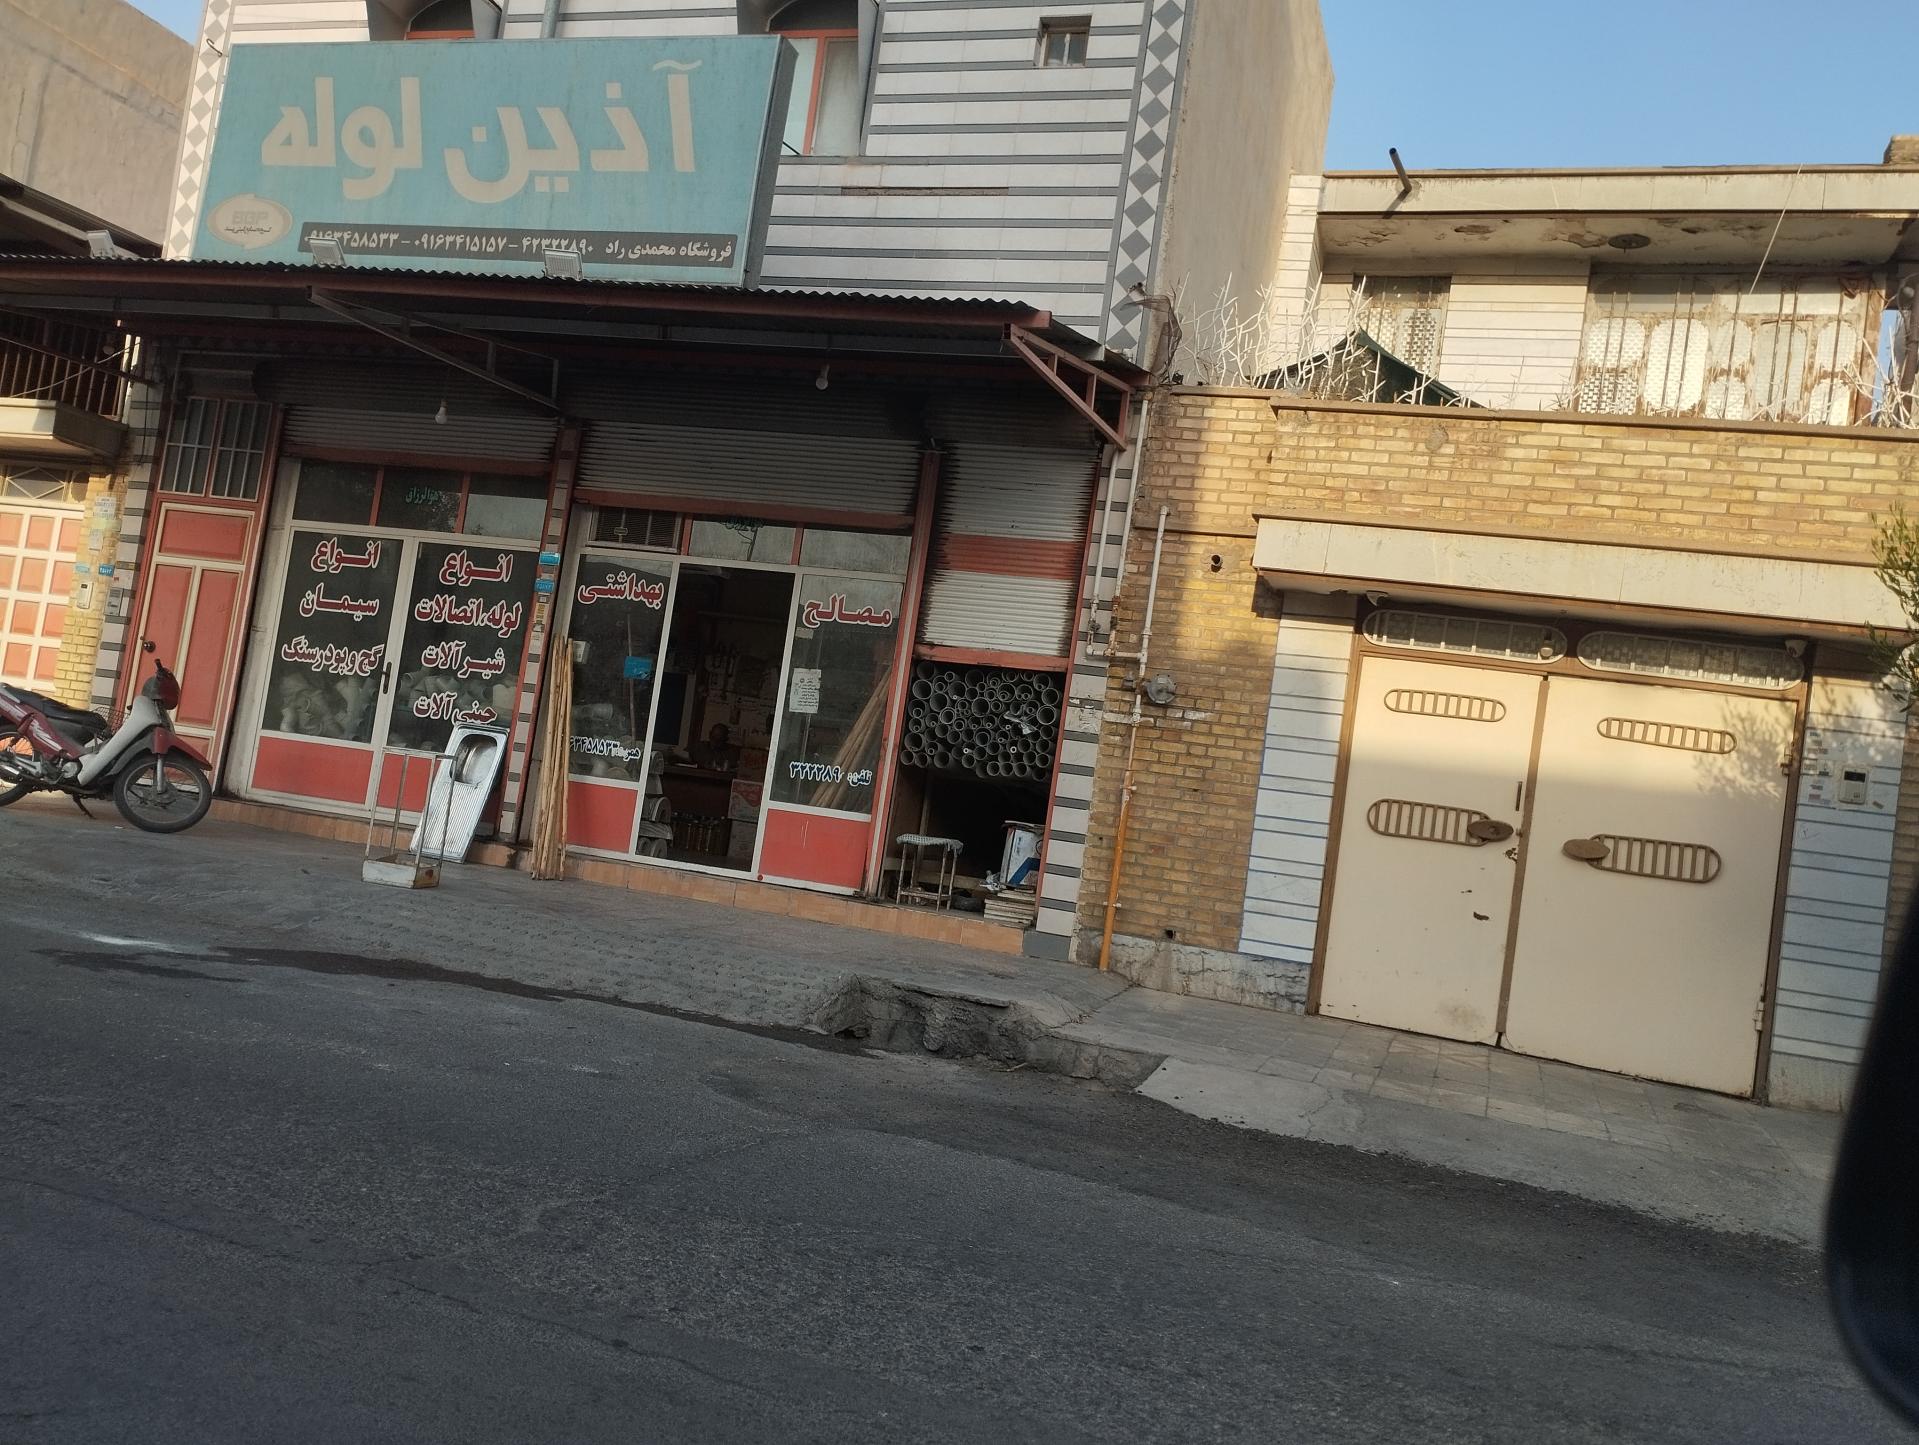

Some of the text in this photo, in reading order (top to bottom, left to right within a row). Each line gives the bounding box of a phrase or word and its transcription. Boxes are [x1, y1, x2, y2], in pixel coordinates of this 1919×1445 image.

[261, 59, 702, 203] آذین لوله
[414, 232, 507, 252] ۰۹۱۶۳۴۱۵۱۵۷
[605, 239, 625, 259] راد
[627, 240, 676, 260] محمدی
[678, 241, 733, 262] فروشگاه
[310, 537, 382, 573] انواع
[439, 549, 513, 586] انواع
[300, 582, 379, 621] سیمان
[577, 571, 664, 610] بهداشتی
[415, 594, 484, 626] اتصالات
[803, 594, 892, 628] مصالح
[281, 635, 320, 663] سنگ
[356, 643, 385, 677] گچ
[421, 640, 505, 679] شیر آلات
[413, 691, 458, 720] آلات
